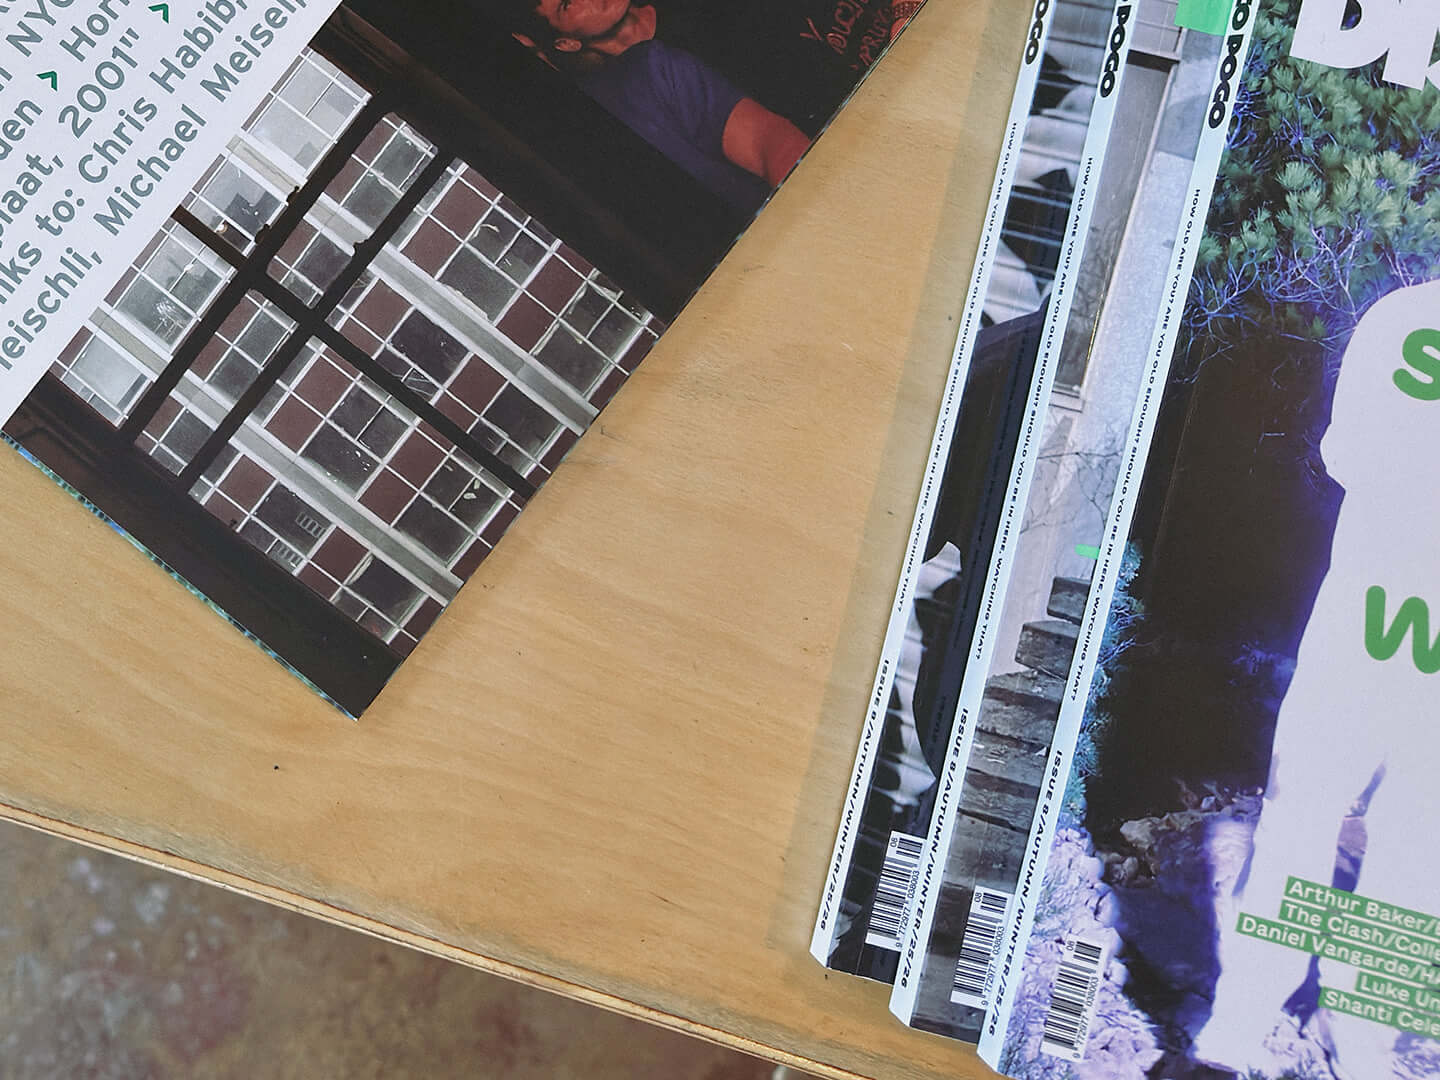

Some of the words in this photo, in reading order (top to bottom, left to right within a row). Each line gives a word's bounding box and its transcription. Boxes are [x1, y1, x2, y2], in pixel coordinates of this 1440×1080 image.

[1099, 4, 1132, 98] POGO
[1207, 33, 1244, 129] POGO
[34, 188, 85, 236] to:
[77, 96, 158, 183] Chris
[92, 102, 206, 236] Michael
[1188, 189, 1201, 217] HOW
[1182, 220, 1193, 244] OLD
[1175, 247, 1186, 269] ARE
[1167, 273, 1181, 303] YOU?
[1161, 306, 1172, 329] ARE
[1154, 333, 1166, 356] YOU
[1148, 359, 1159, 383] OLD
[1133, 387, 1152, 443] ENOUGH?
[1120, 446, 1137, 494] SHOULD
[1113, 498, 1125, 522] YOU
[1105, 543, 1114, 555] IN
[1109, 525, 1118, 540] BE
[1095, 559, 1110, 592] HERE,
[1079, 596, 1101, 660] WATCHING
[873, 659, 890, 706] ISSUE
[1069, 664, 1084, 700] THAT?
[951, 707, 969, 757] ISSUE
[1044, 750, 1063, 800] ISSUE
[819, 710, 877, 929] 8/AUTUMN/WINTER/25/26
[900, 760, 957, 987] 8/AUTUMN/WINTER/25/26
[1288, 880, 1361, 912] Arthur
[987, 803, 1049, 1035] 8/AUTUMN/WINTER/25/26
[1284, 902, 1322, 928] The
[1241, 916, 1307, 948] Daniel
[1360, 974, 1410, 1002] Luke
[1323, 989, 1393, 1023] Shanti
